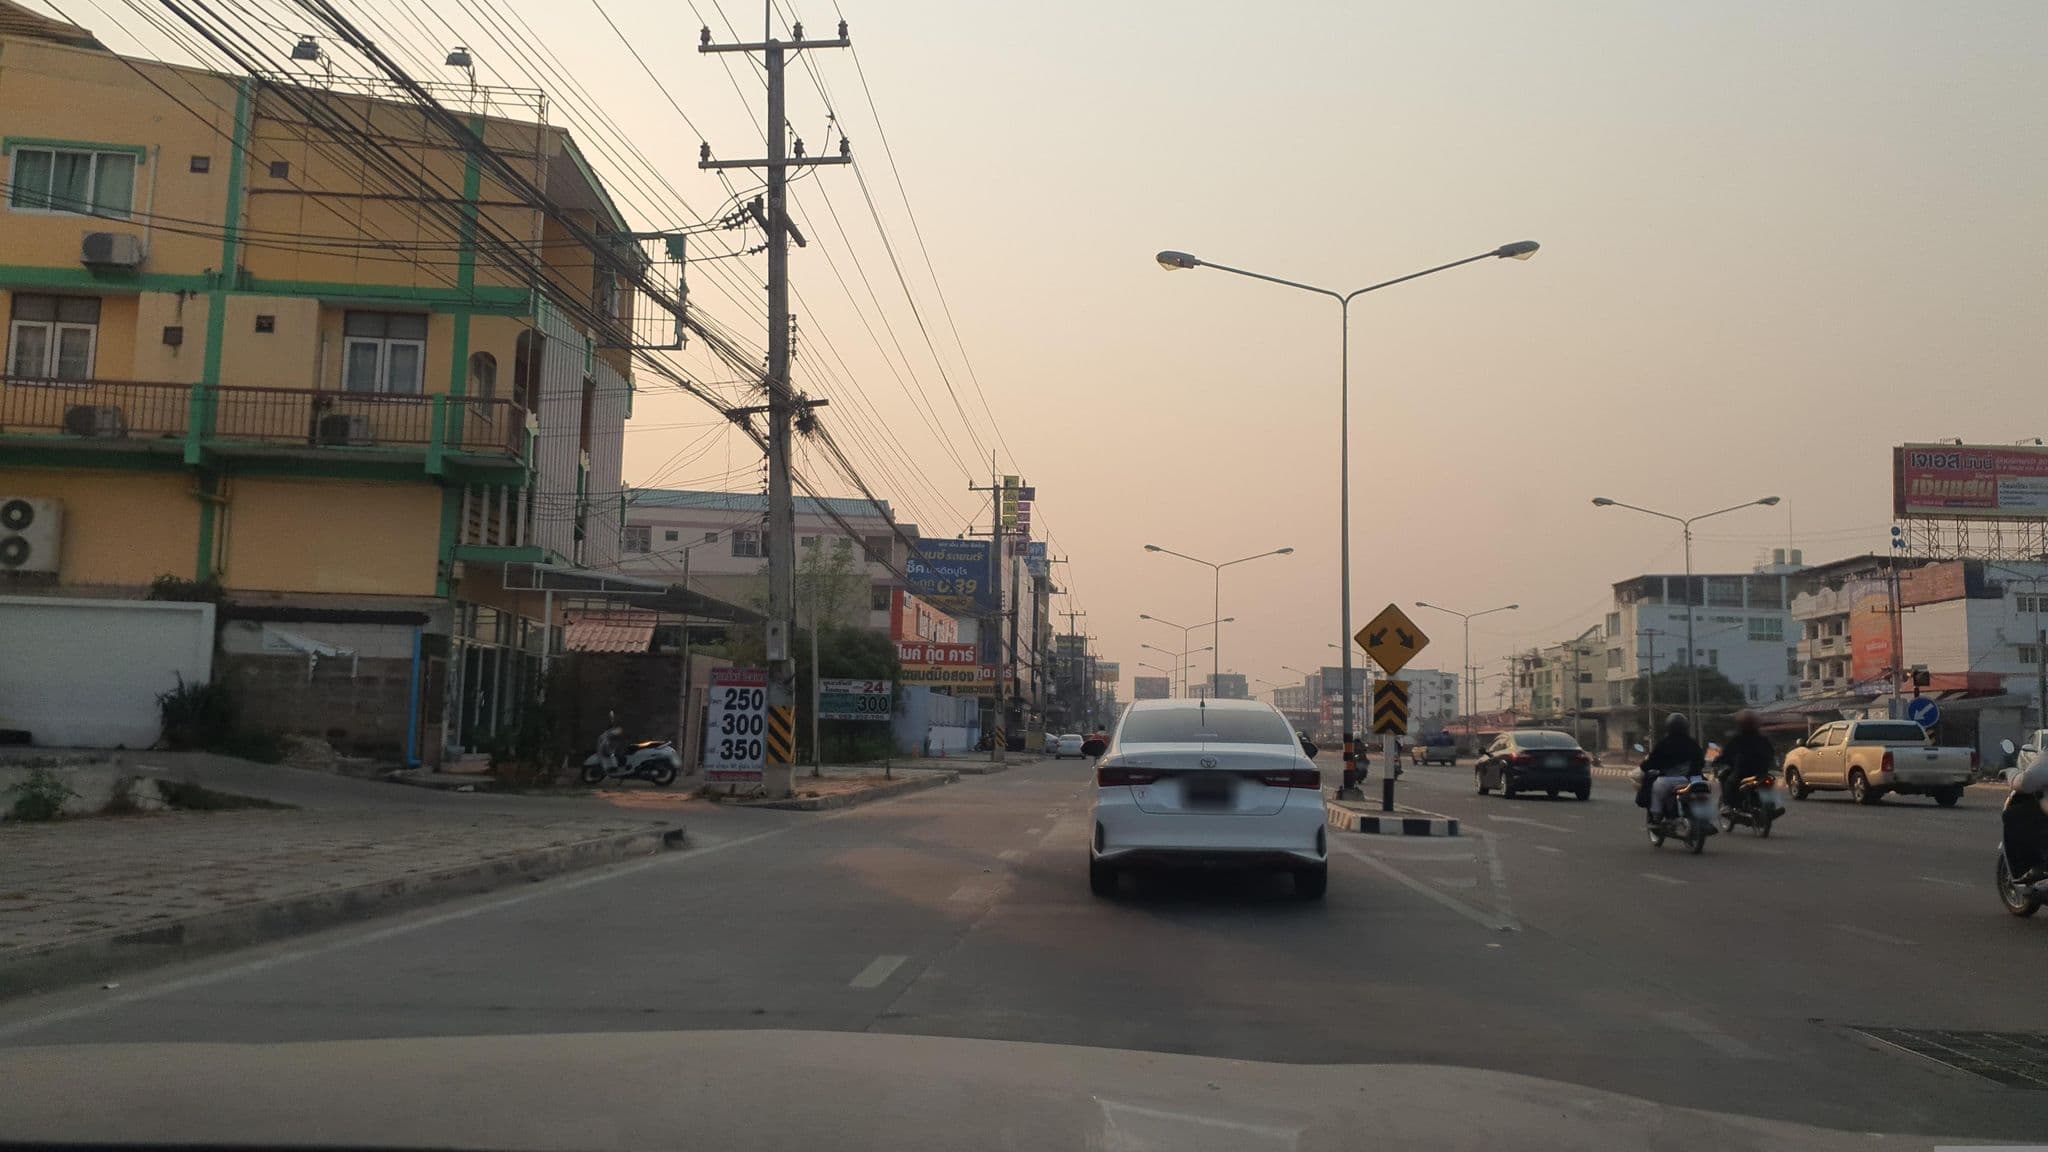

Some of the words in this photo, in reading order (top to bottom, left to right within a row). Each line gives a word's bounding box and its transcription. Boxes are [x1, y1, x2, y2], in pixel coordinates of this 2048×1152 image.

[949, 646, 975, 662] คาร์
[724, 688, 764, 711] 250
[857, 696, 888, 713] 300
[721, 713, 763, 735] 300
[720, 739, 762, 760] 350
